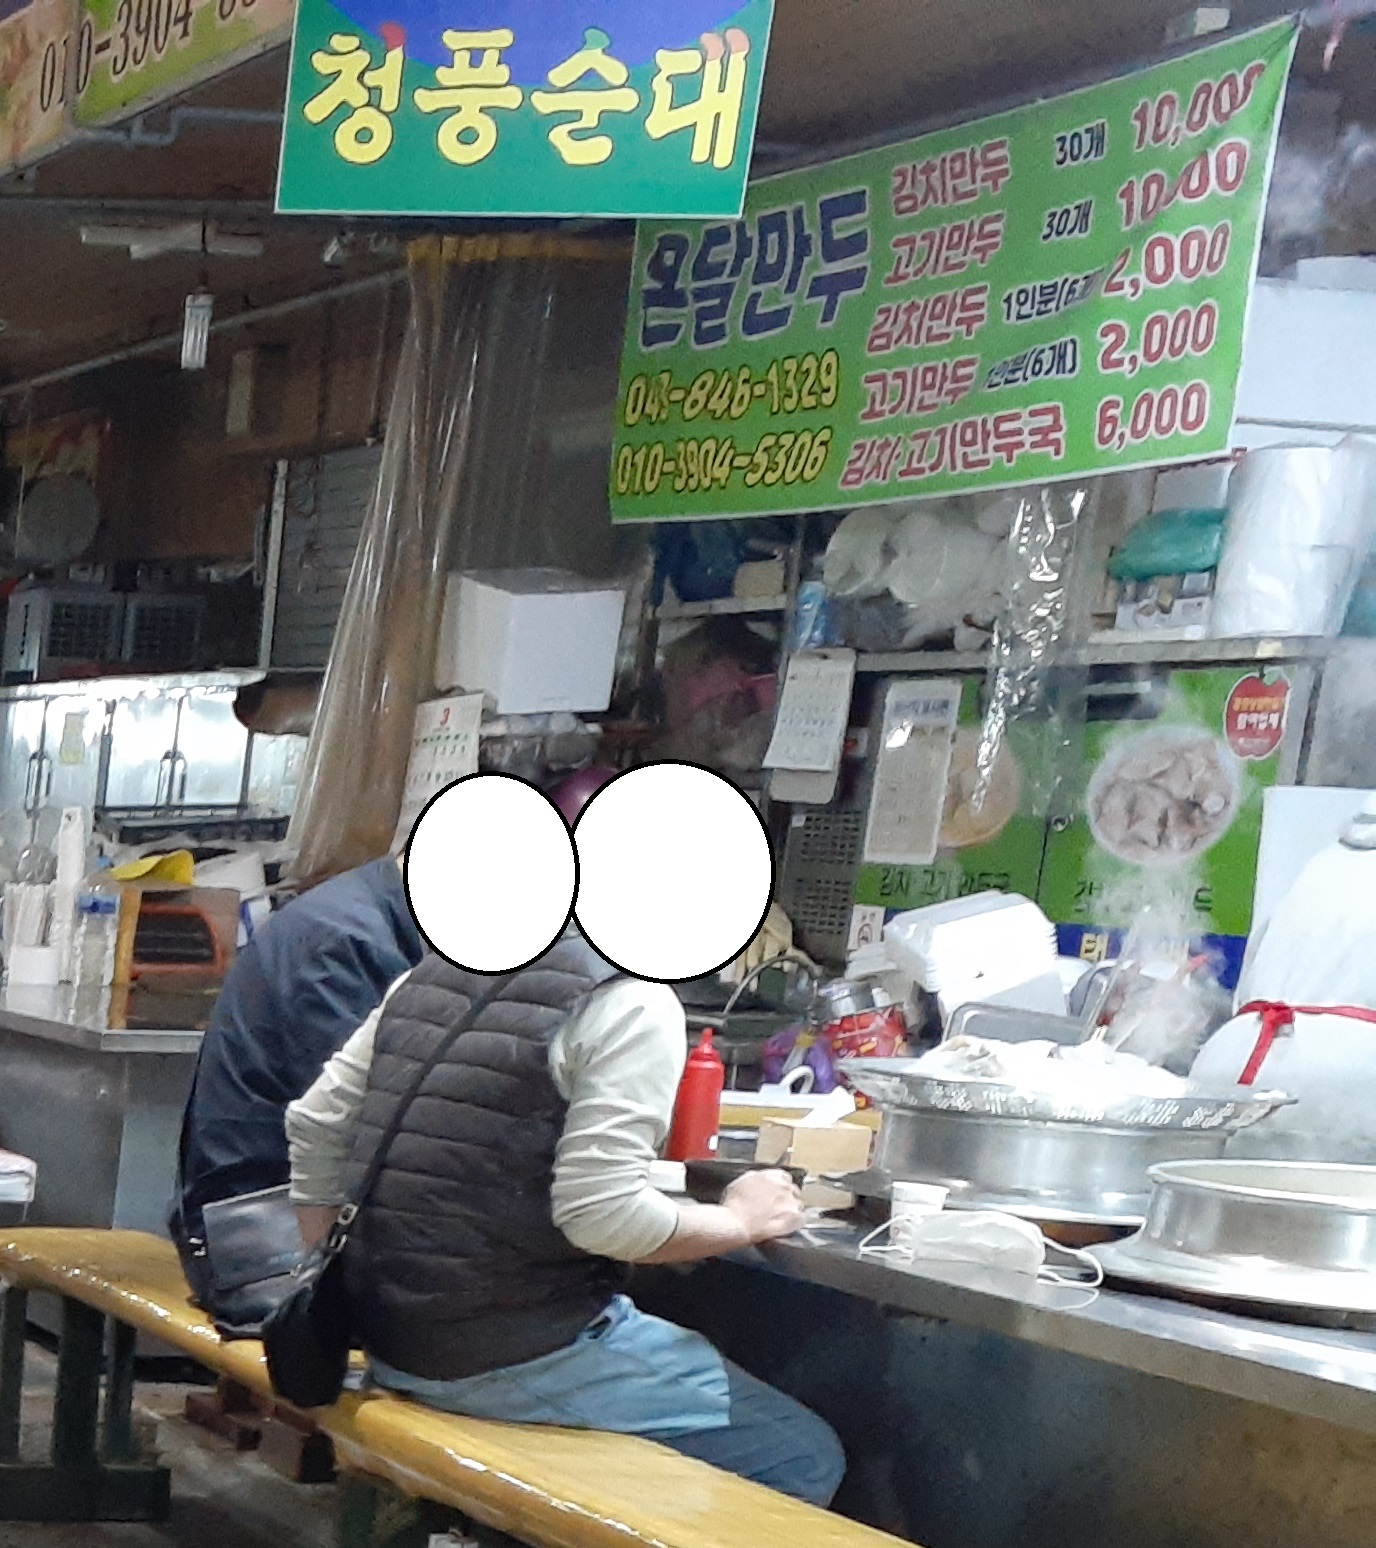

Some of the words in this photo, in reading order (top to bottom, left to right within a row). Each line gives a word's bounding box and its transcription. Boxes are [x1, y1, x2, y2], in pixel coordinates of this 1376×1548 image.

[302, 23, 750, 168] 청풍순대
[891, 137, 1011, 217] 김치만두
[1054, 122, 1107, 167] 30개
[639, 188, 869, 347] 온달만두
[866, 283, 990, 356] 김치만두
[1102, 222, 1231, 299] 2,000
[882, 210, 1007, 287] 고기만두
[1041, 199, 1094, 242] 30개
[858, 355, 979, 421] 고기만두
[1098, 302, 1218, 376] 2,000
[616, 425, 833, 496] 010-3904-5306
[1096, 381, 1209, 450] 6,000
